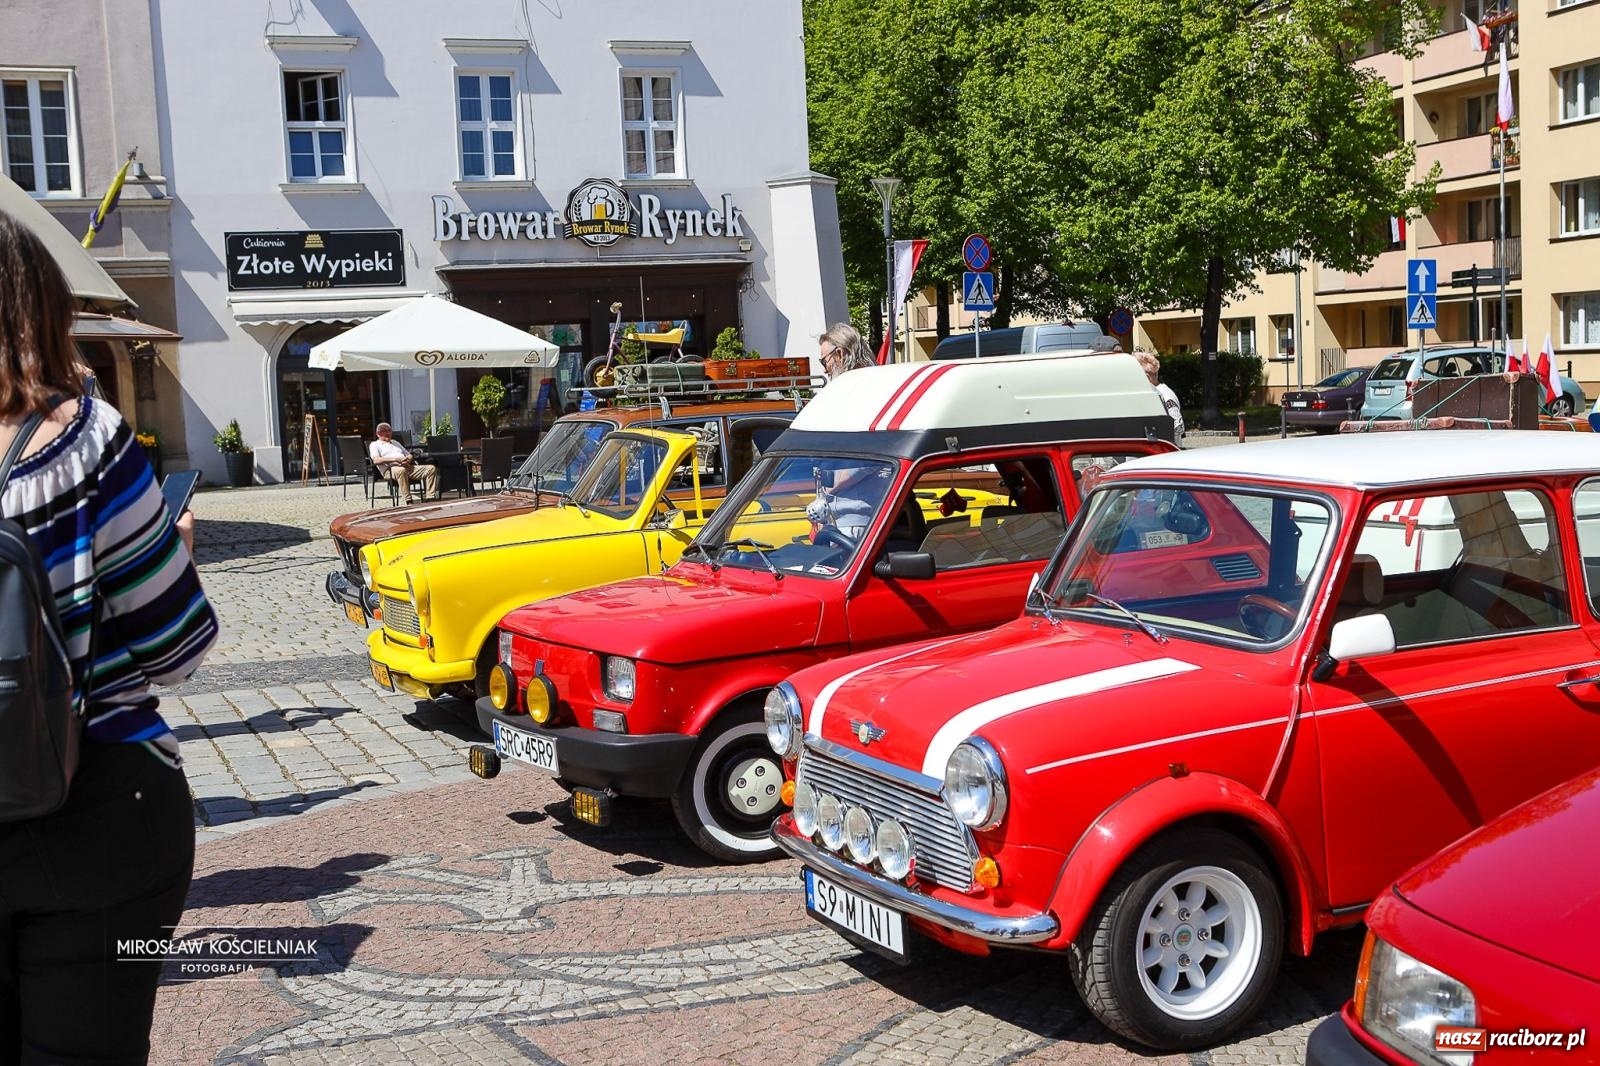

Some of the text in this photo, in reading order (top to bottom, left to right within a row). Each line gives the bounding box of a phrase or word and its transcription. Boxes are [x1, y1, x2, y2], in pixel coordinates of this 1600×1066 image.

[433, 193, 745, 244] Browar Rynek
[572, 220, 629, 235] Browar Rynek
[243, 237, 286, 249] Cukiernia
[237, 250, 393, 278] Złote Wypieki
[306, 280, 331, 288] 2013
[446, 353, 485, 361] ALGIDA
[818, 880, 891, 946] S9 MINI
